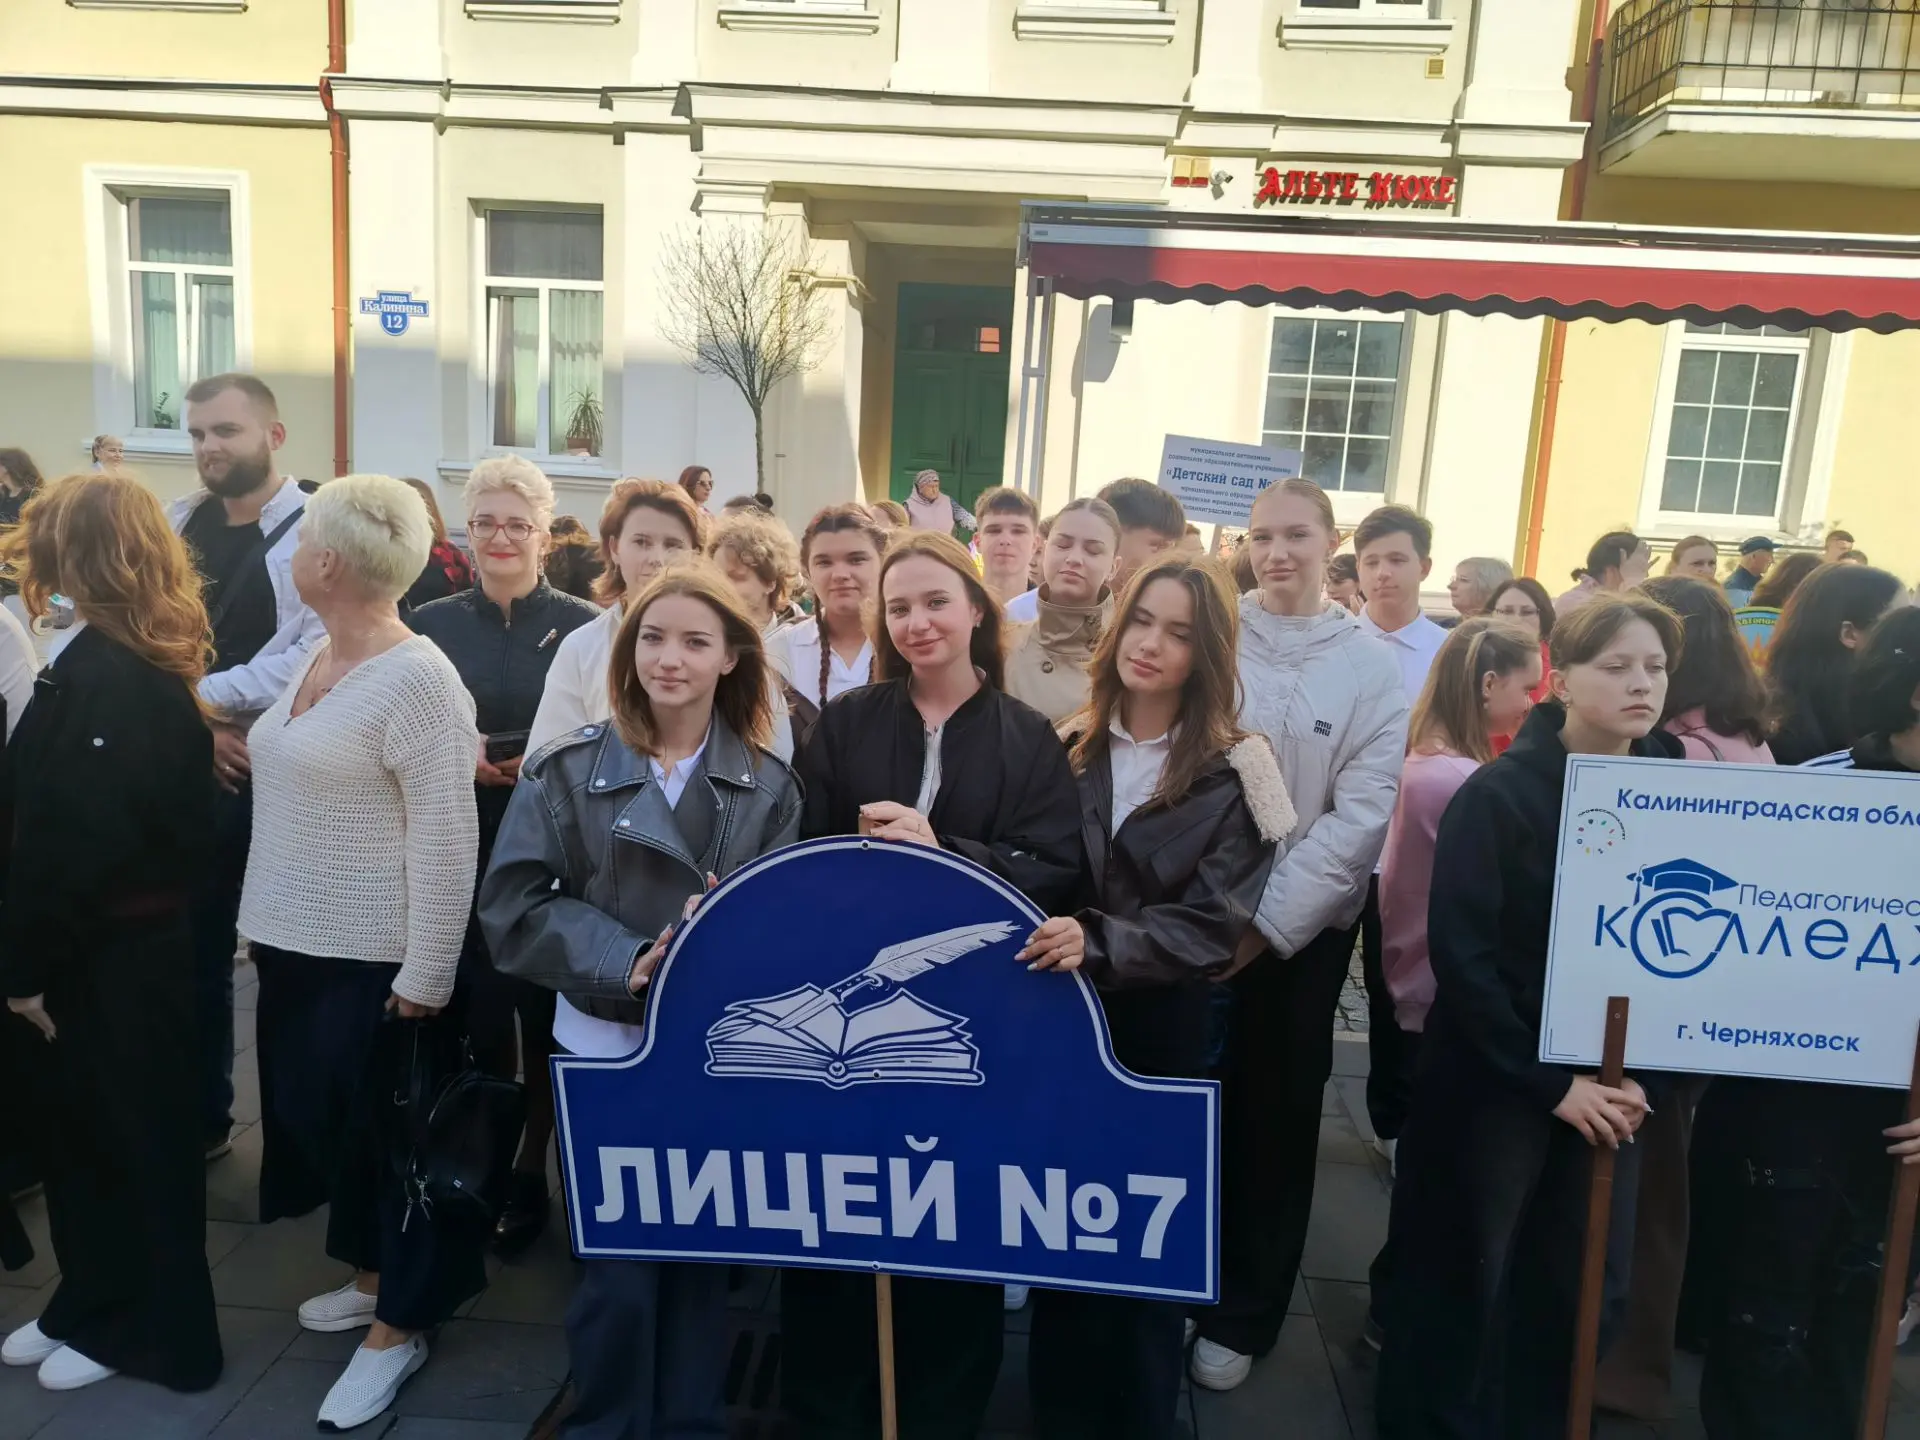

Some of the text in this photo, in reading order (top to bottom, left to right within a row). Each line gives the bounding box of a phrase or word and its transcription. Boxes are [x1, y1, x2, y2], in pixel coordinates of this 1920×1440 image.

[364, 300, 424, 314] Калинина
[380, 295, 407, 303] улица
[386, 315, 403, 328] 12
[1166, 467, 1227, 484] «Детский
[1231, 476, 1254, 489] сад
[1616, 788, 1920, 827] Калининградская обл
[1677, 1021, 1860, 1052] г. Черняховск
[595, 1134, 1187, 1260] ЛИЦЕЙ №7
